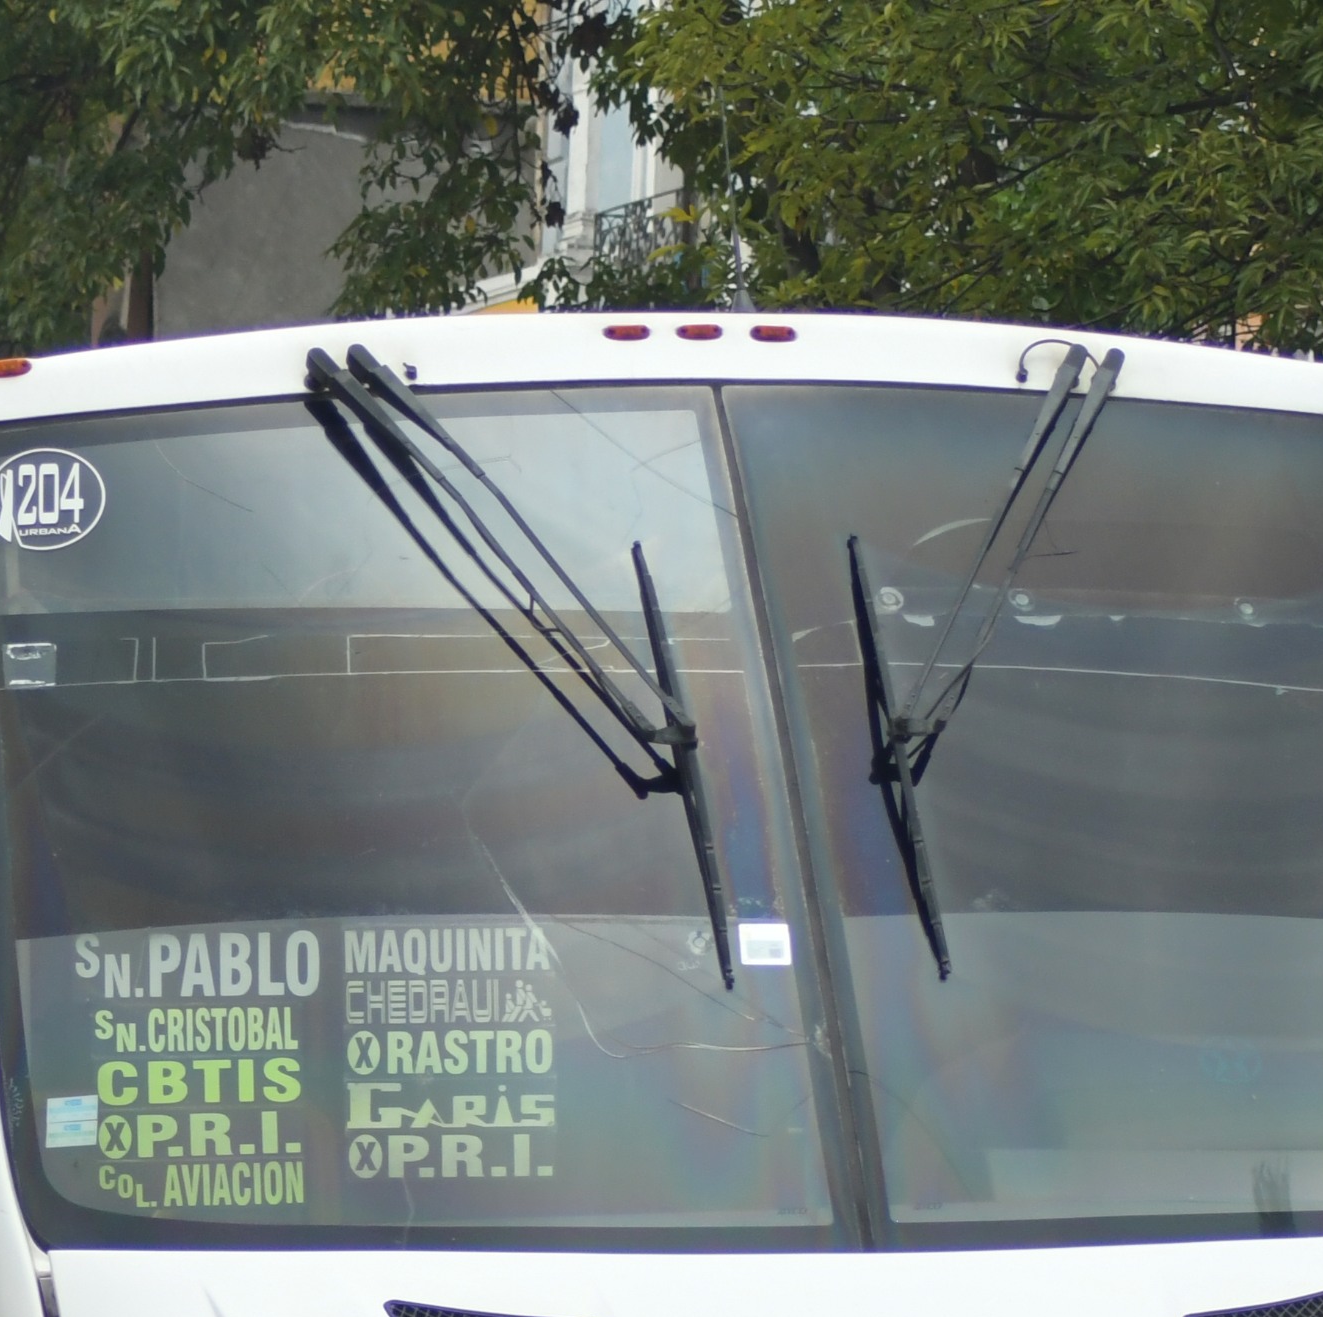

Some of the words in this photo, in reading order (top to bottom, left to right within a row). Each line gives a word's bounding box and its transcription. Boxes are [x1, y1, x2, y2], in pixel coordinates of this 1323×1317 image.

[19, 523, 82, 536] URBANA
[345, 927, 552, 976] MAQUINITA
[345, 979, 500, 1025] CHEDRAUI
[387, 1030, 553, 1075] RASTRO
[96, 1057, 302, 1106] CBTIS
[137, 1111, 302, 1158] P.R.I.
[387, 1133, 554, 1178] P.R.I.
[164, 1161, 305, 1207] AVIACION
